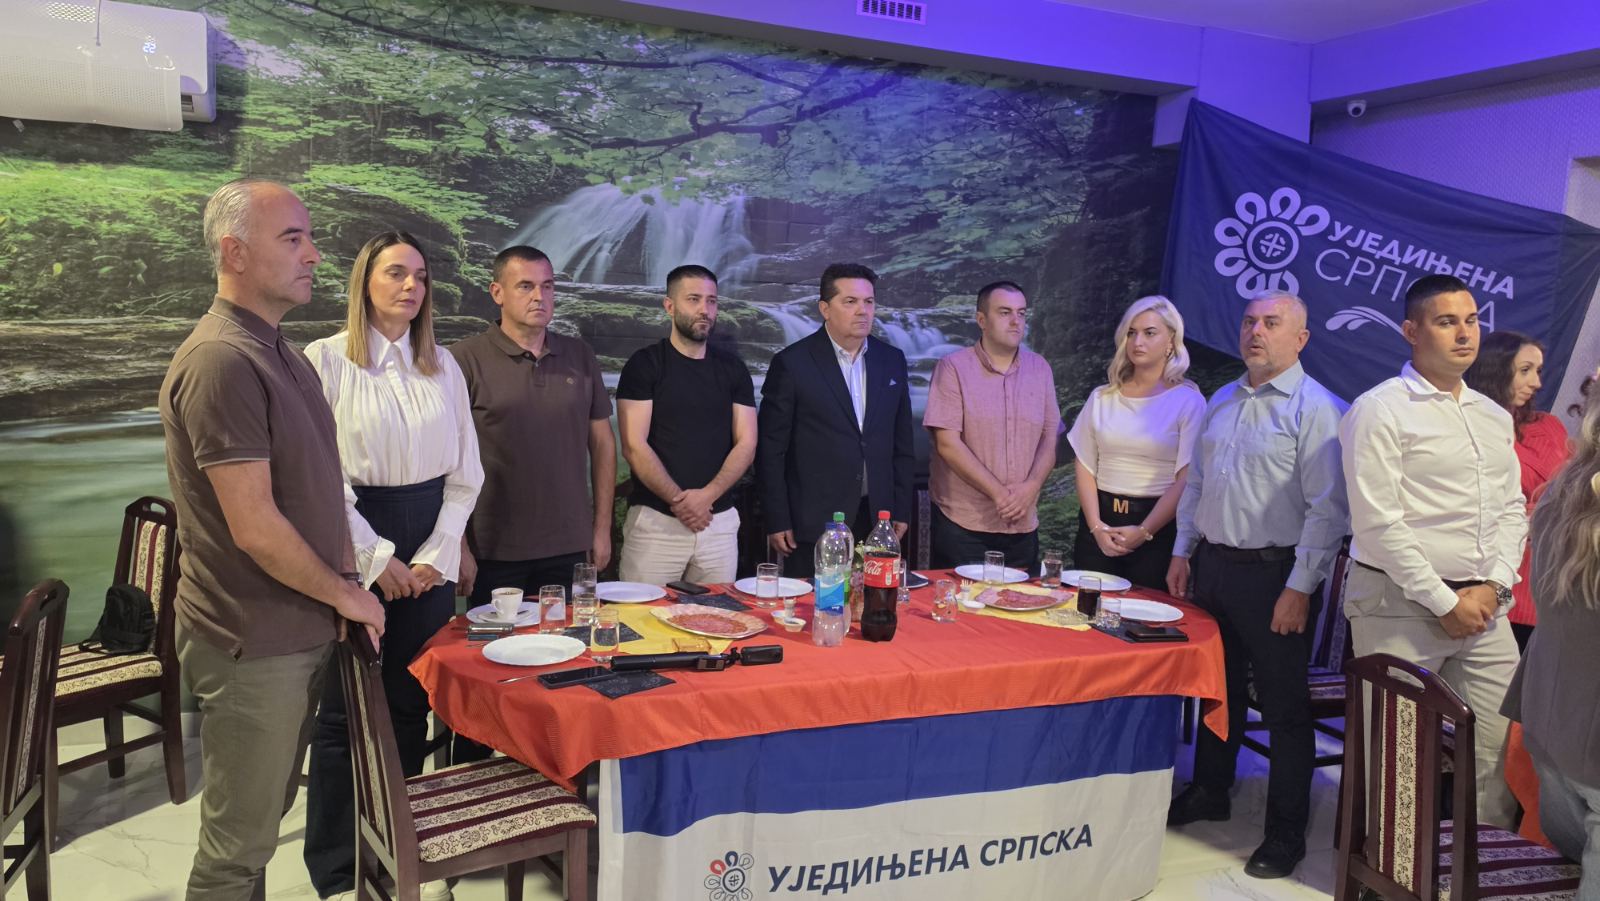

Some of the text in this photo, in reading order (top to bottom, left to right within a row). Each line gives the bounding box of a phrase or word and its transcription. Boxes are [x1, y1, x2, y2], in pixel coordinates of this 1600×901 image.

[1315, 248, 1495, 333] СРПА
[1328, 220, 1515, 300] УЈЕДИЊЕНА
[1113, 497, 1129, 514] M
[767, 823, 1093, 896] УЈЕДИЊЕНА СРПСКА
